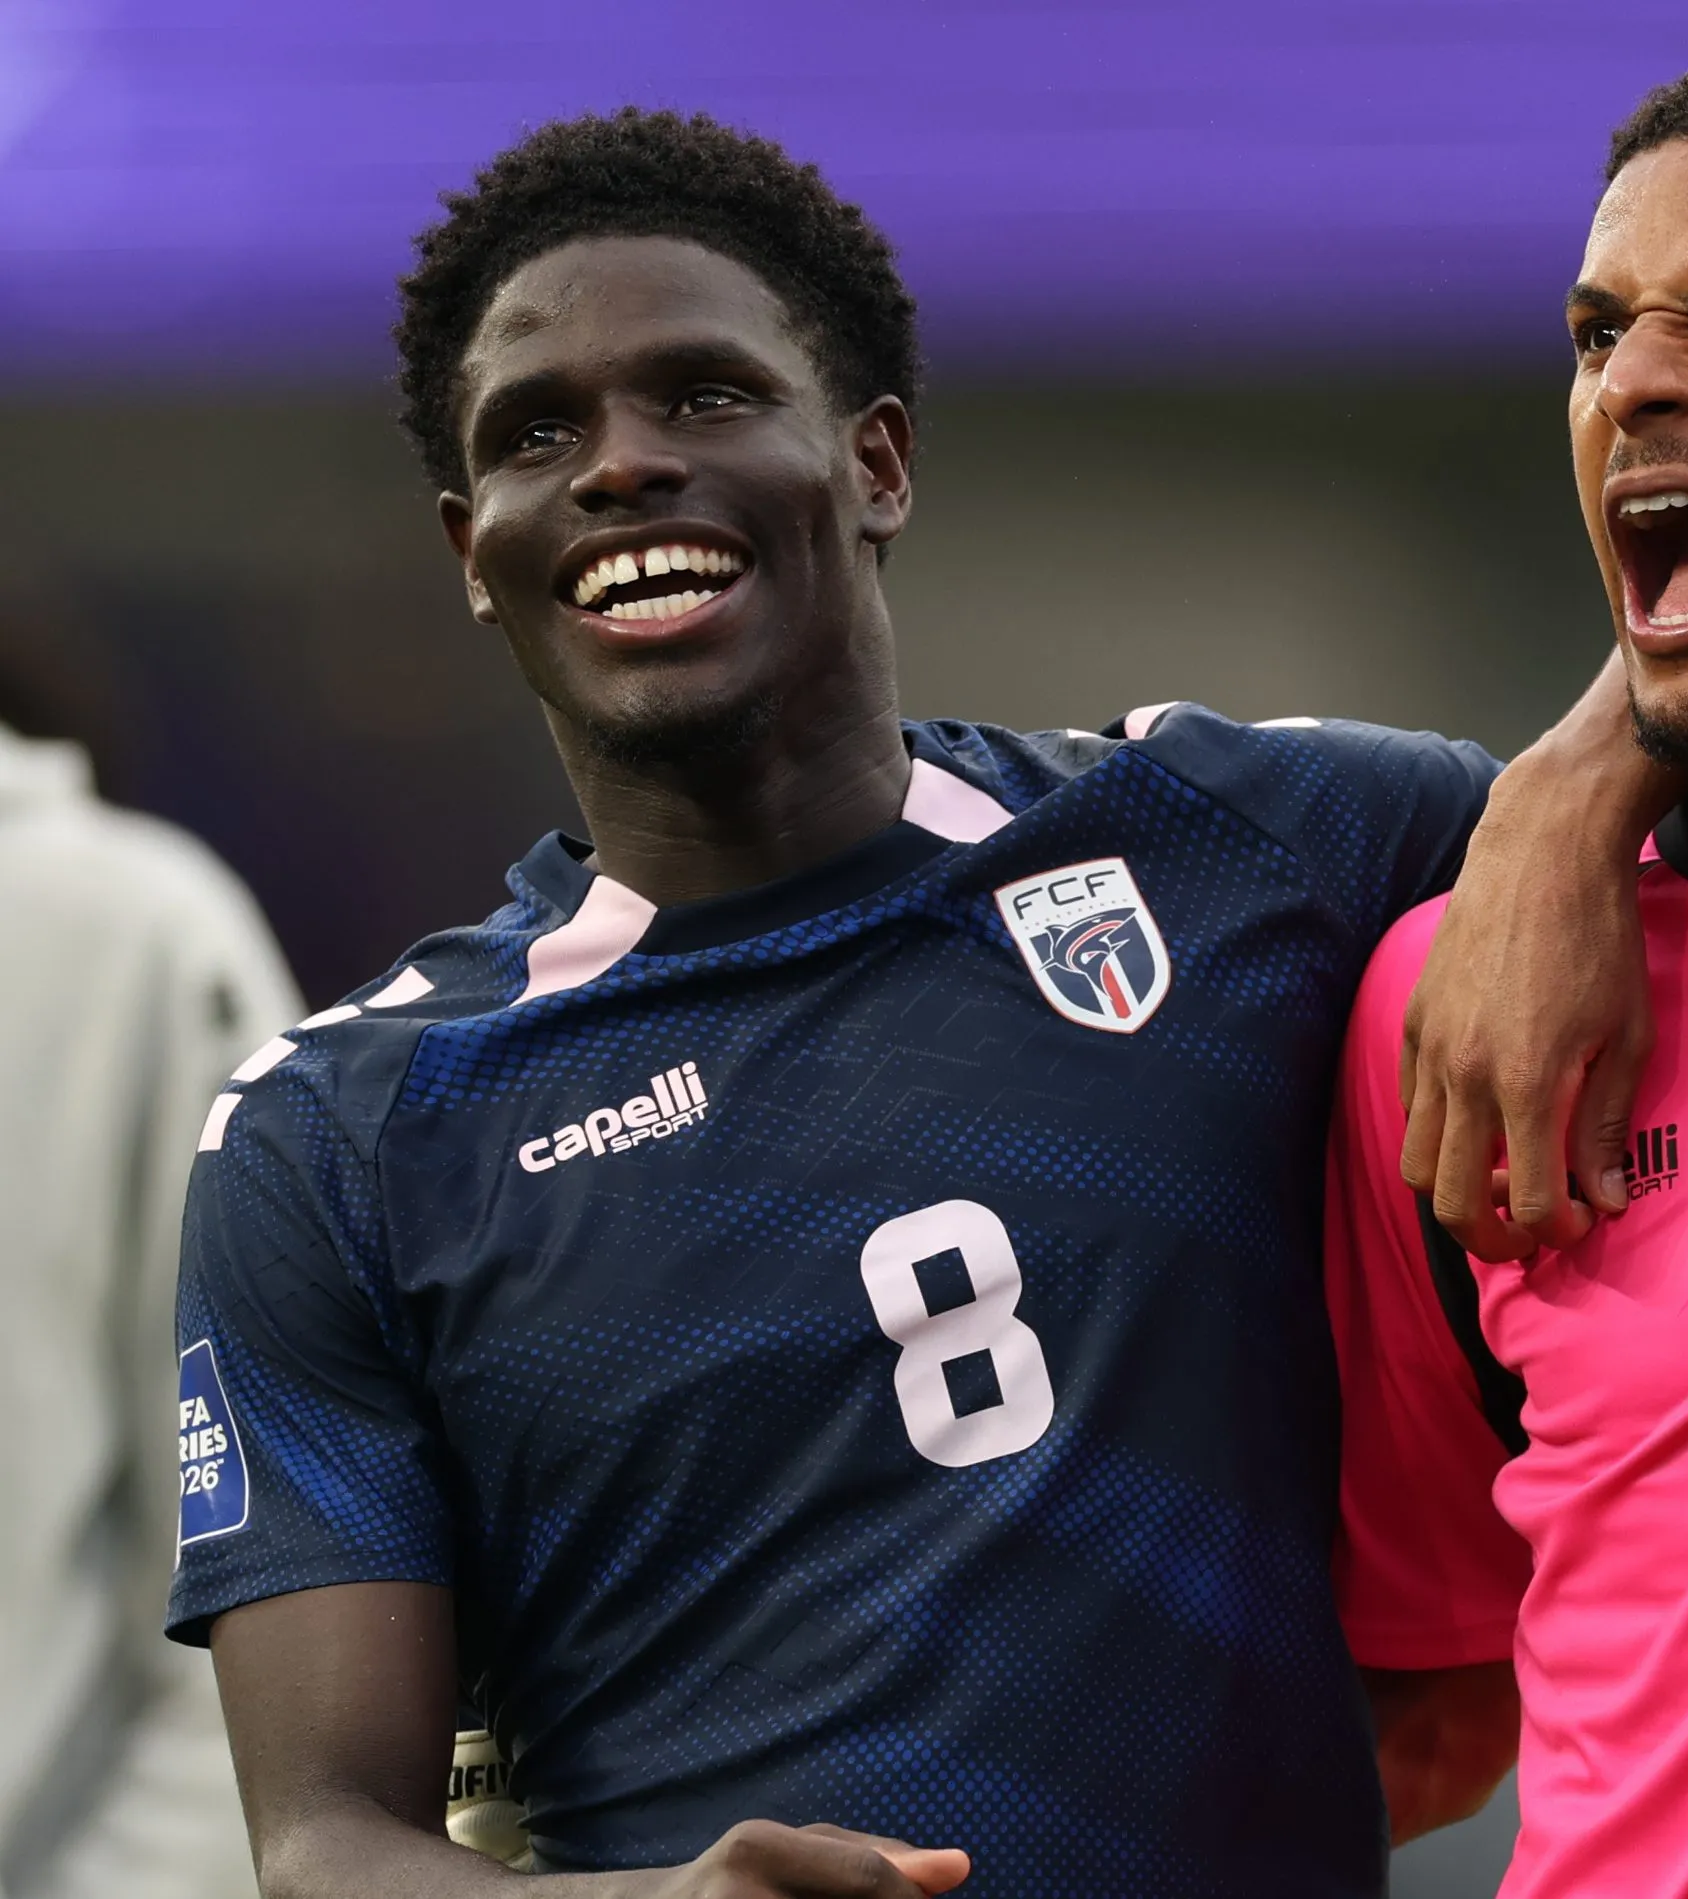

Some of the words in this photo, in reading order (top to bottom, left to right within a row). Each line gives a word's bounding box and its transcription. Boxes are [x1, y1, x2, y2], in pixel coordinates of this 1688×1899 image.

[1013, 870, 1116, 920] FCF
[518, 1061, 707, 1173] capelli
[612, 1102, 709, 1154] SPORT
[860, 1199, 1054, 1468] 8
[180, 1396, 211, 1431] FA
